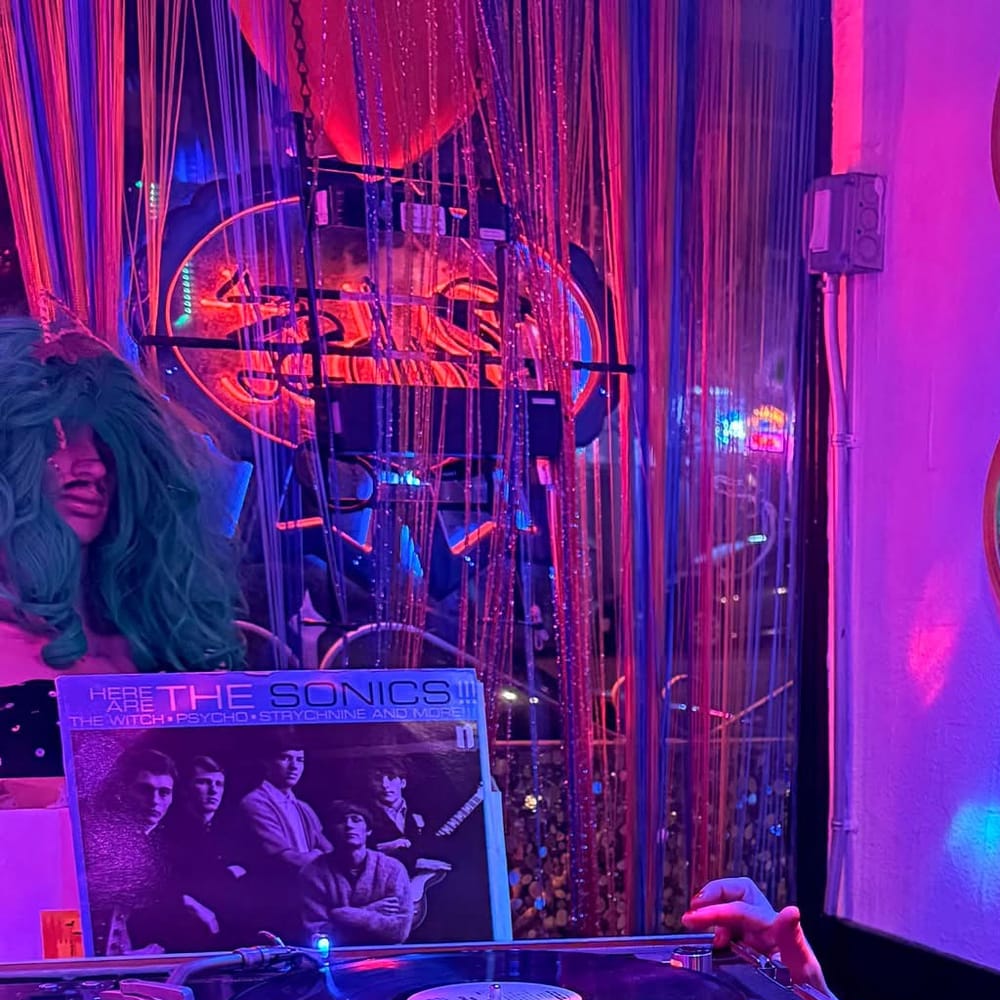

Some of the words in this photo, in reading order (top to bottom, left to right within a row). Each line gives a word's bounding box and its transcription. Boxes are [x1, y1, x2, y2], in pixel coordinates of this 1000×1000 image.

[90, 686, 153, 701] HERE
[156, 683, 256, 712] THE
[106, 699, 155, 713] ARE
[69, 714, 103, 728] THE
[109, 713, 165, 727] WITCH
[176, 711, 248, 725] PSYCHO
[259, 707, 366, 722] STRYCHNINE
[372, 706, 407, 720] AND
